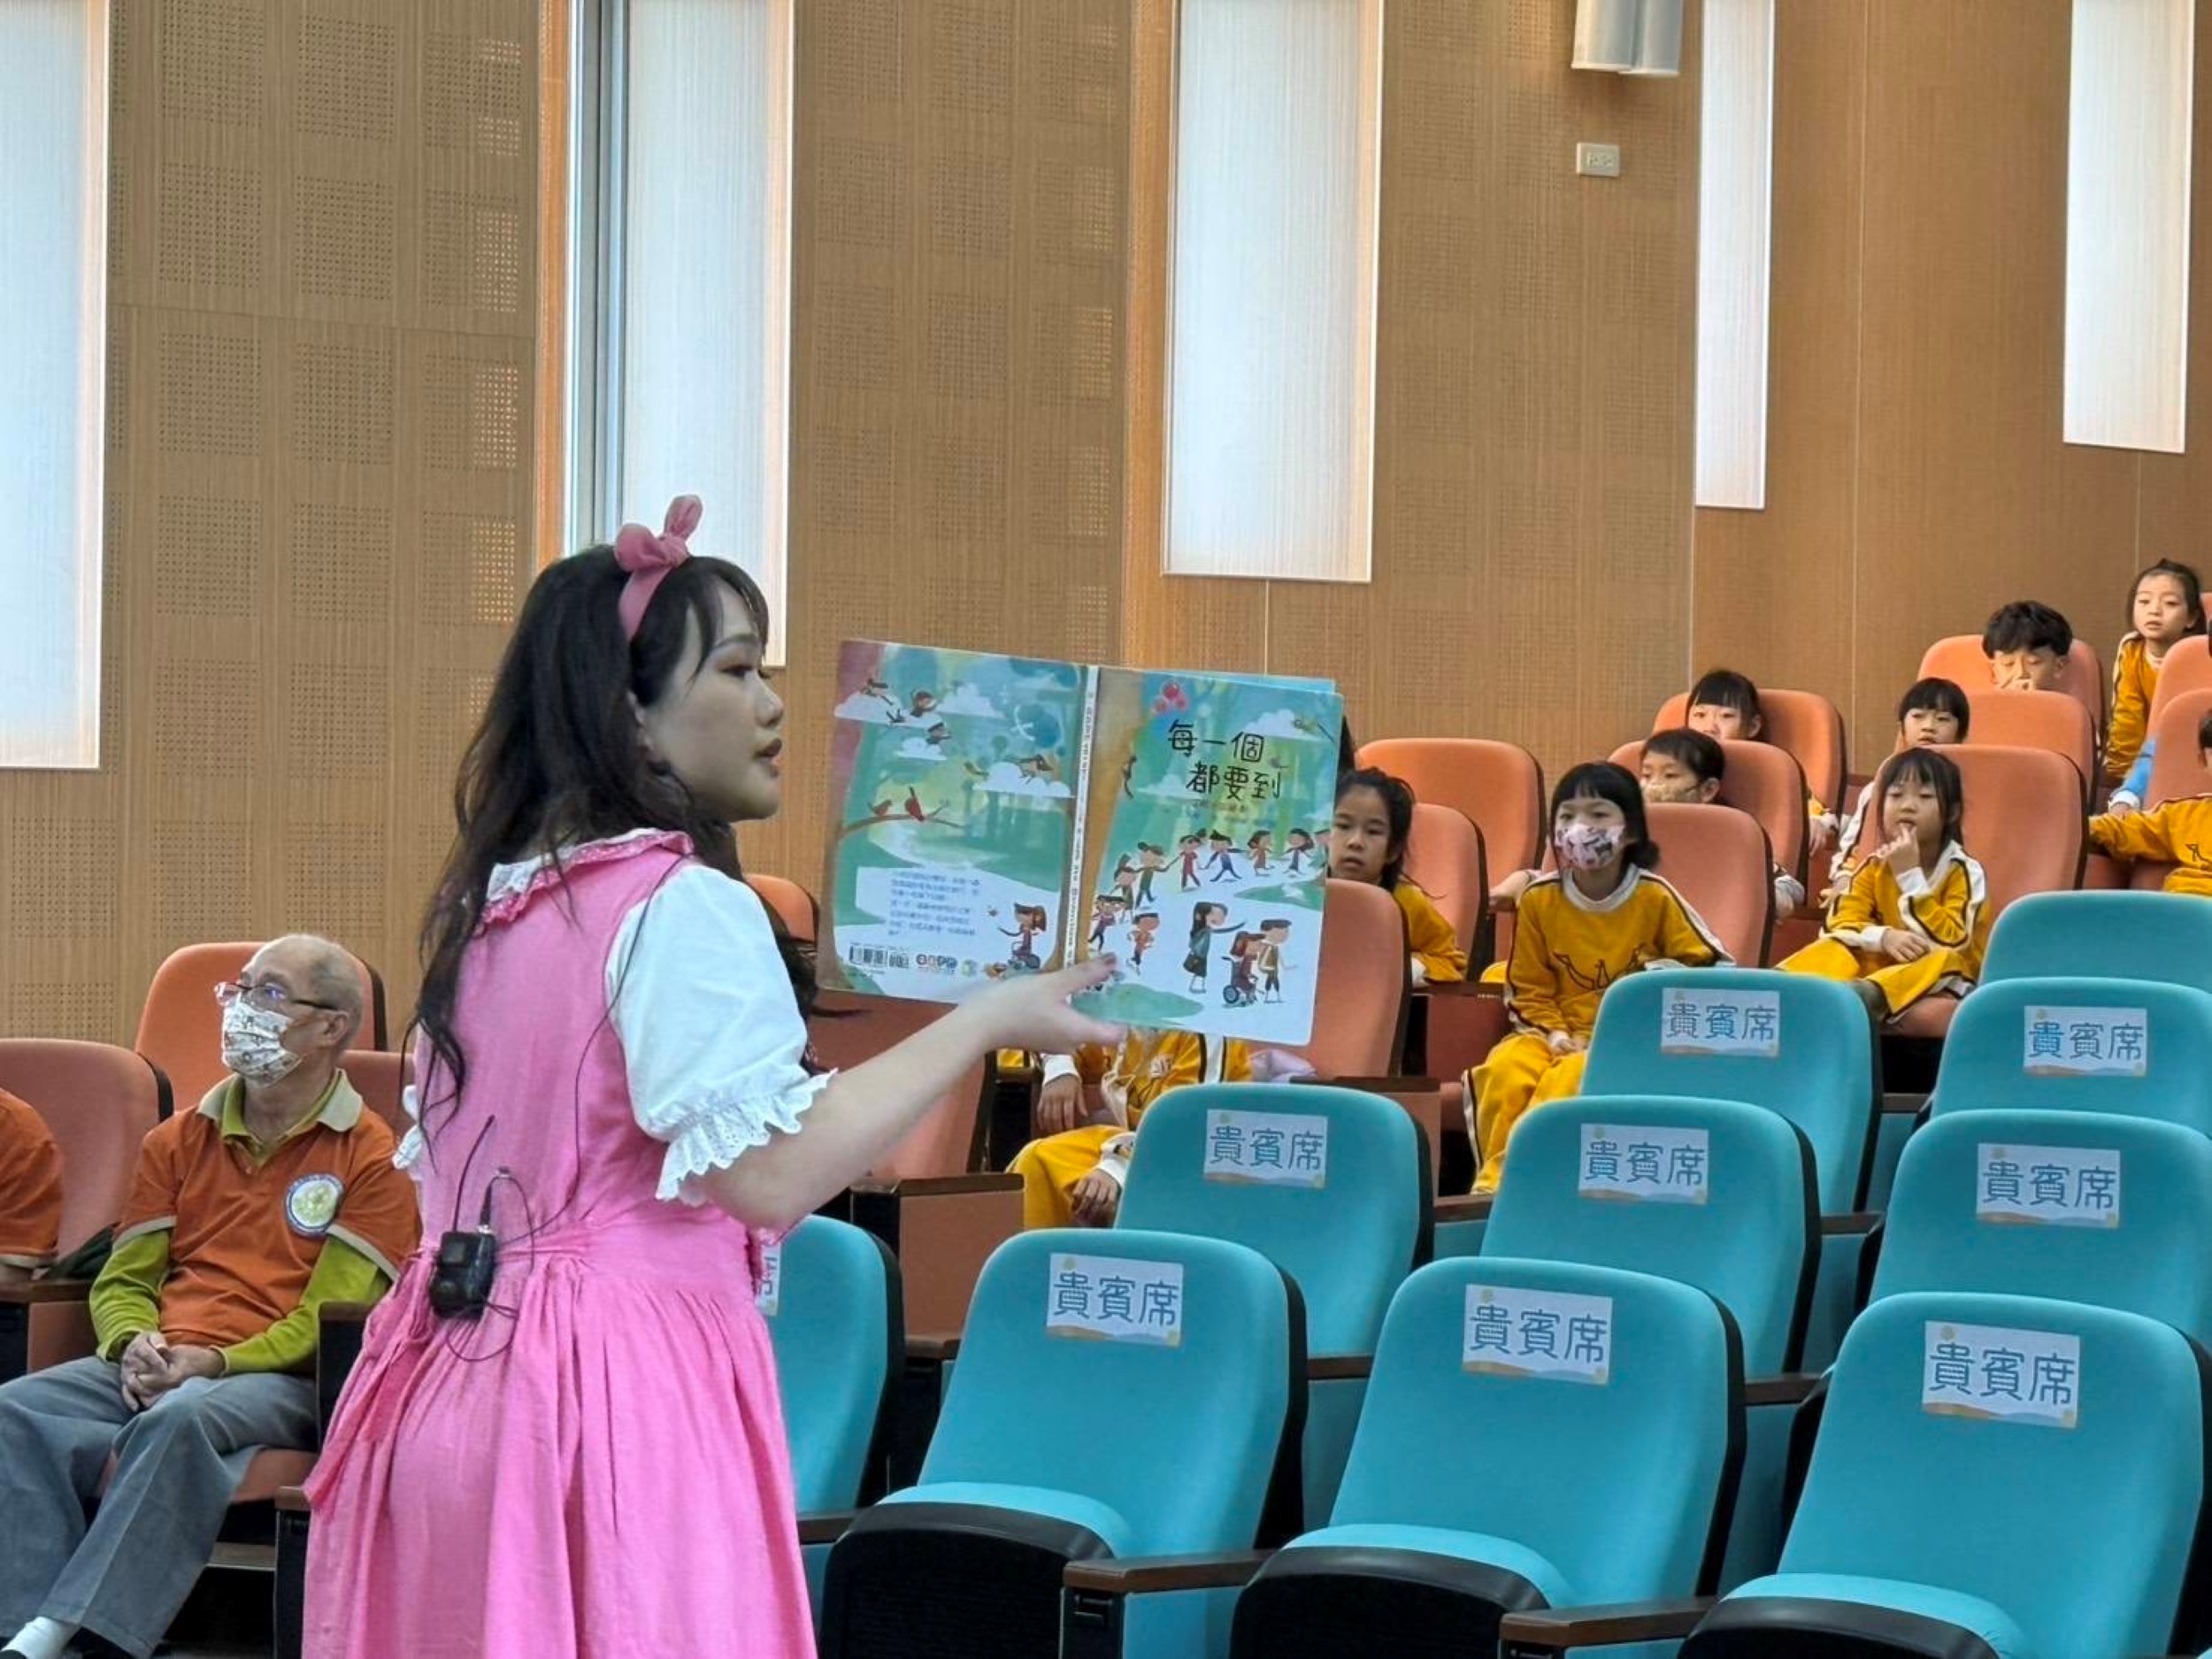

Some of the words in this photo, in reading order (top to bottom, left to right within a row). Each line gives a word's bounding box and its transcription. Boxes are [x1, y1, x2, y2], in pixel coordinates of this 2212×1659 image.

[1167, 719, 1264, 762] 每一個
[1186, 760, 1281, 801] 都要到
[1666, 1002, 1777, 1041] 貴賓席
[2028, 1021, 2144, 1060] 貴賓席
[1210, 1125, 1325, 1170] 貴賓席
[1585, 1140, 1705, 1186] 貴賓席
[1982, 1160, 2116, 1210] 貴賓席
[1053, 1271, 1179, 1326] 貴賓席
[1470, 1304, 1608, 1363] 貴賓席
[1928, 1342, 2075, 1405] 貴賓席
